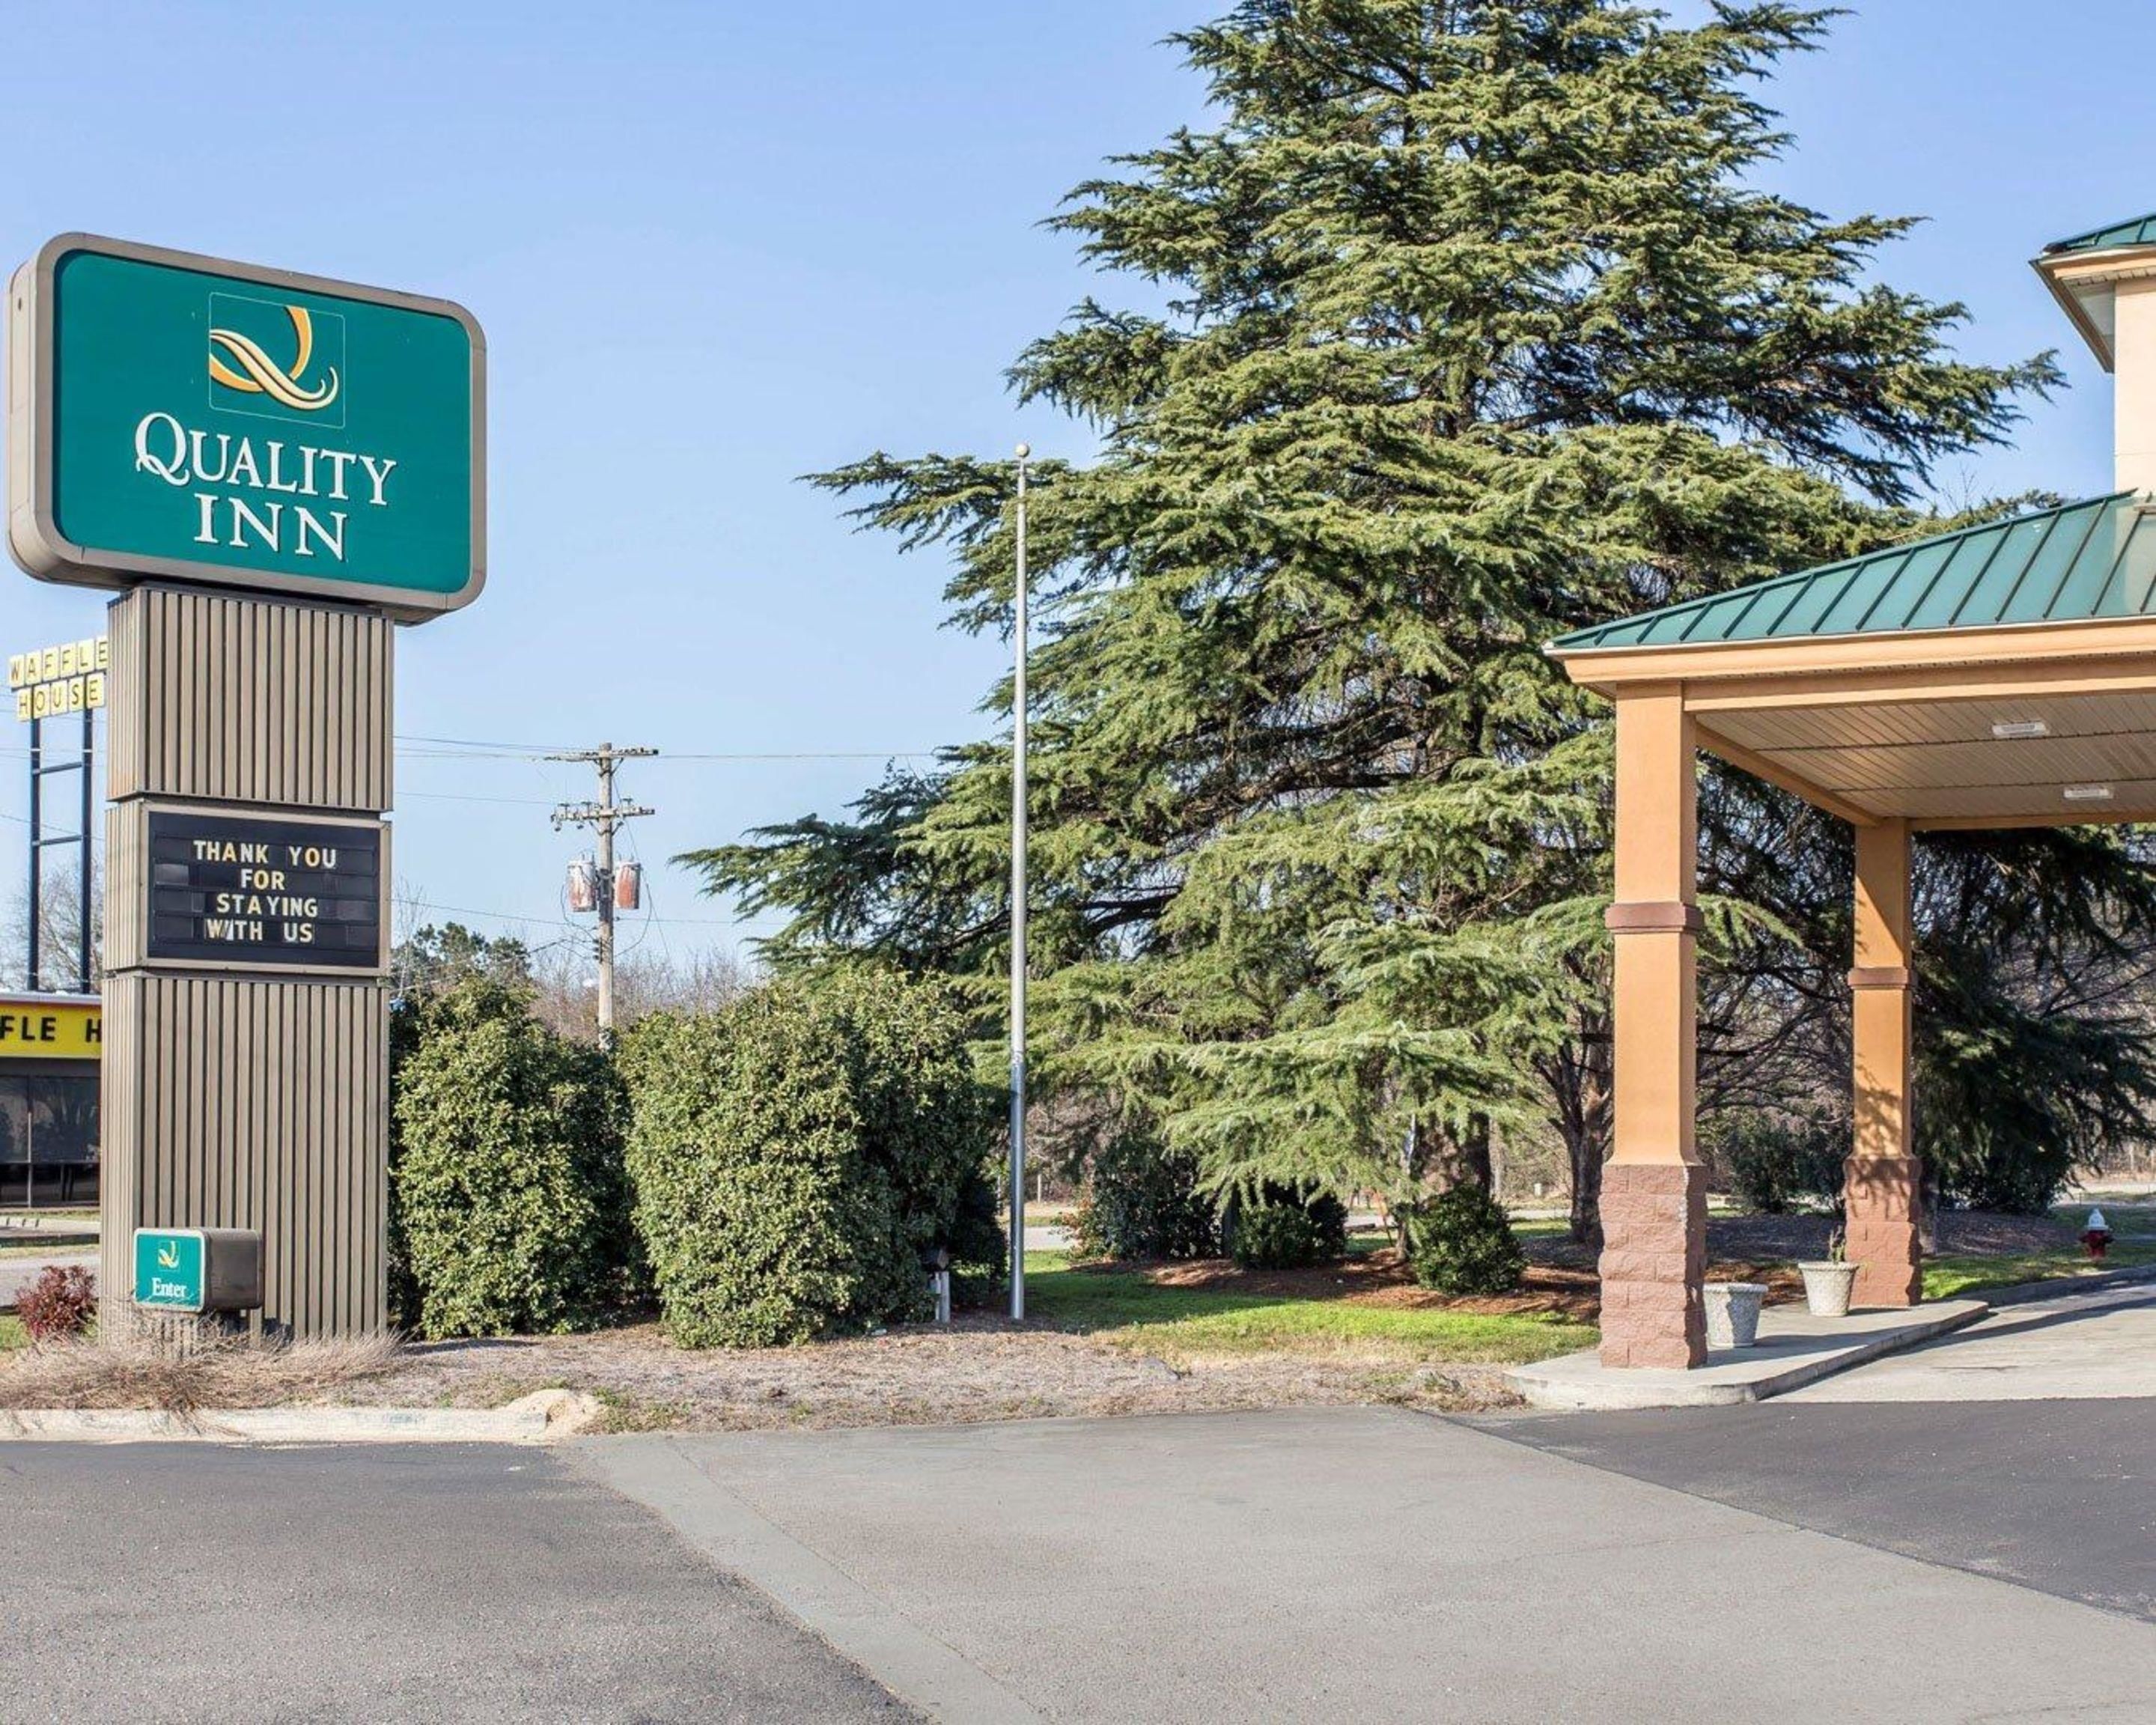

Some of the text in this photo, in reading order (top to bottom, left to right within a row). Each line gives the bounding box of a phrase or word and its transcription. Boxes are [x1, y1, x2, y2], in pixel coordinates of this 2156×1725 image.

[135, 412, 397, 507] QUALITY
[193, 492, 348, 562] INN
[11, 641, 107, 681] WAFFLE
[19, 679, 98, 715] HOUSE
[193, 839, 336, 869] THANK YOU
[240, 868, 284, 890] FOR
[216, 892, 317, 917] STAYING
[206, 918, 313, 943] WITH US
[151, 1277, 187, 1297] Enter
